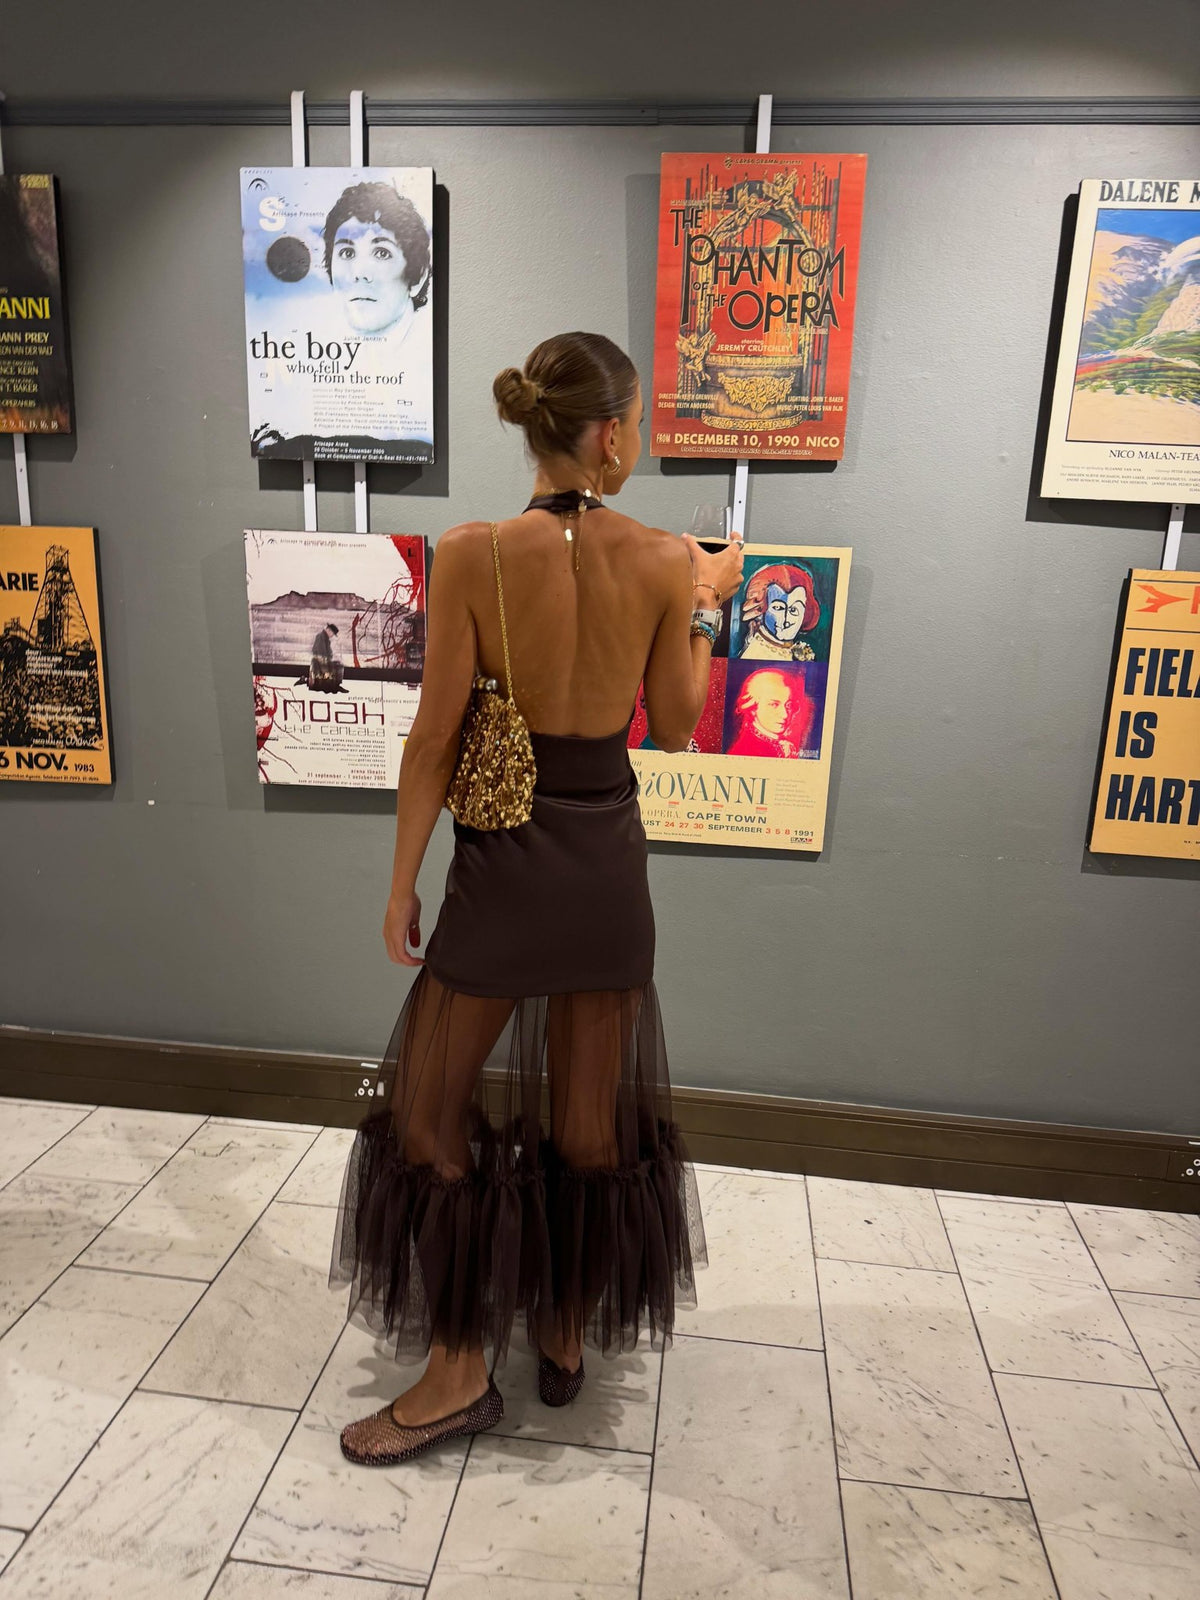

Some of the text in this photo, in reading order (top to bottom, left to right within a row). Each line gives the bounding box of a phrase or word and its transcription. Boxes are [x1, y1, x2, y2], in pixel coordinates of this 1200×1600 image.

[1099, 181, 1180, 202] DALENE
[259, 196, 286, 232] S
[670, 208, 703, 246] THE
[680, 234, 846, 327] PHANTOM
[692, 281, 708, 302] OF
[706, 294, 727, 312] THE
[728, 287, 840, 333] OPERA
[25, 332, 50, 343] PREY
[250, 331, 362, 370] the boy
[716, 344, 792, 352] JEREMY CRUTCHLEY
[286, 360, 339, 374] who fell
[313, 370, 404, 385] from the roof
[656, 433, 840, 448] FROM DECEMBER 10, 1990 NICO
[1109, 450, 1135, 458] NICO
[1124, 648, 1200, 698] FIEL
[283, 700, 384, 726] noah
[284, 724, 386, 737] the cantata
[1115, 710, 1158, 759] IS
[16, 752, 68, 770] NOV.
[74, 763, 94, 772] 1983
[687, 811, 721, 821] CAPE
[726, 814, 767, 824] TOWN
[708, 824, 762, 833] SEPTEMBER
